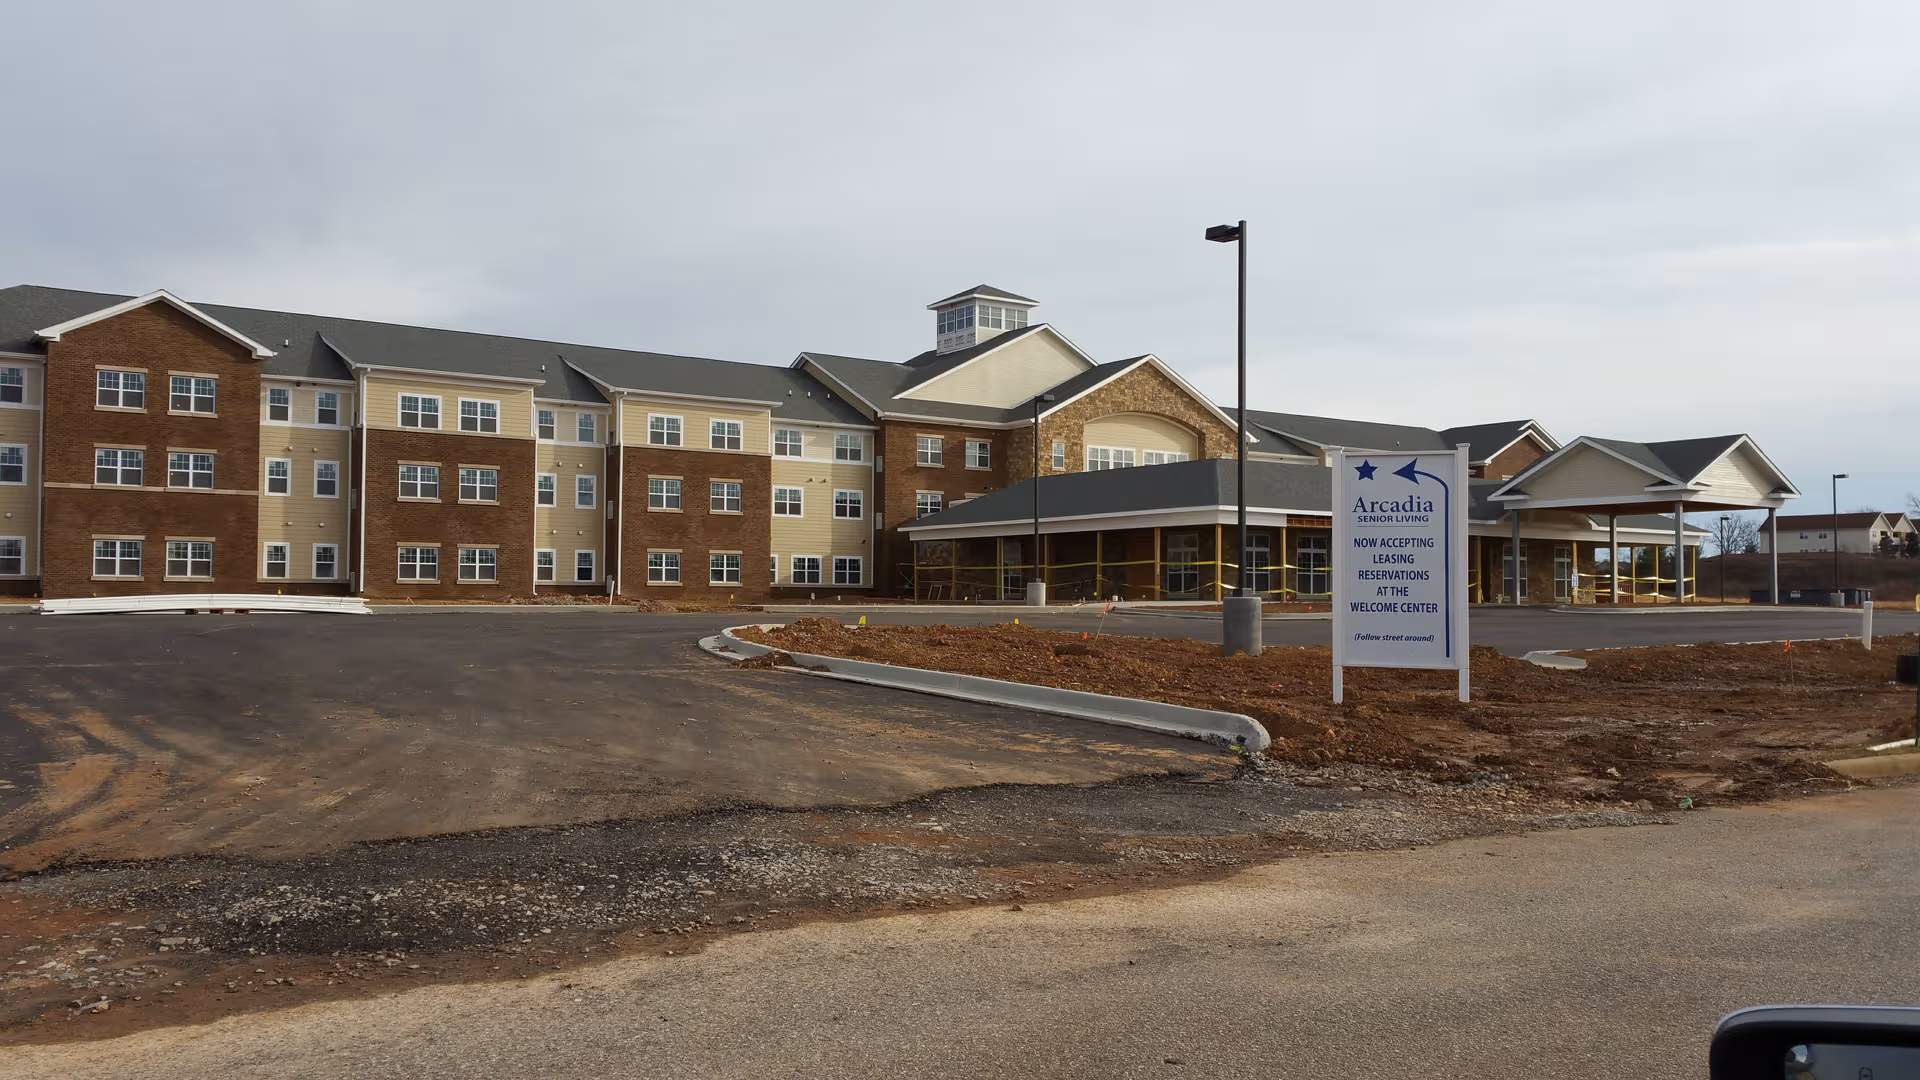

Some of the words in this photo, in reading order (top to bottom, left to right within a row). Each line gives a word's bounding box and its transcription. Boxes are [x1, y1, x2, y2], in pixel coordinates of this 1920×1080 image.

[1352, 495, 1434, 513] Arcadia
[1357, 515, 1393, 523] SENIOR
[1395, 514, 1429, 523] LIVING
[1353, 537, 1378, 548] NOW
[1379, 537, 1434, 548] ACCEPTING
[1373, 553, 1415, 564] LEASING
[1358, 570, 1430, 580] RESERVATIONS
[1376, 586, 1388, 597] AT
[1390, 586, 1409, 597] THE
[1350, 602, 1398, 613] WELCOME
[1400, 602, 1438, 613] CENTER
[1354, 633, 1380, 642] (Follow
[1382, 634, 1403, 642] street
[1405, 634, 1435, 643] around)
